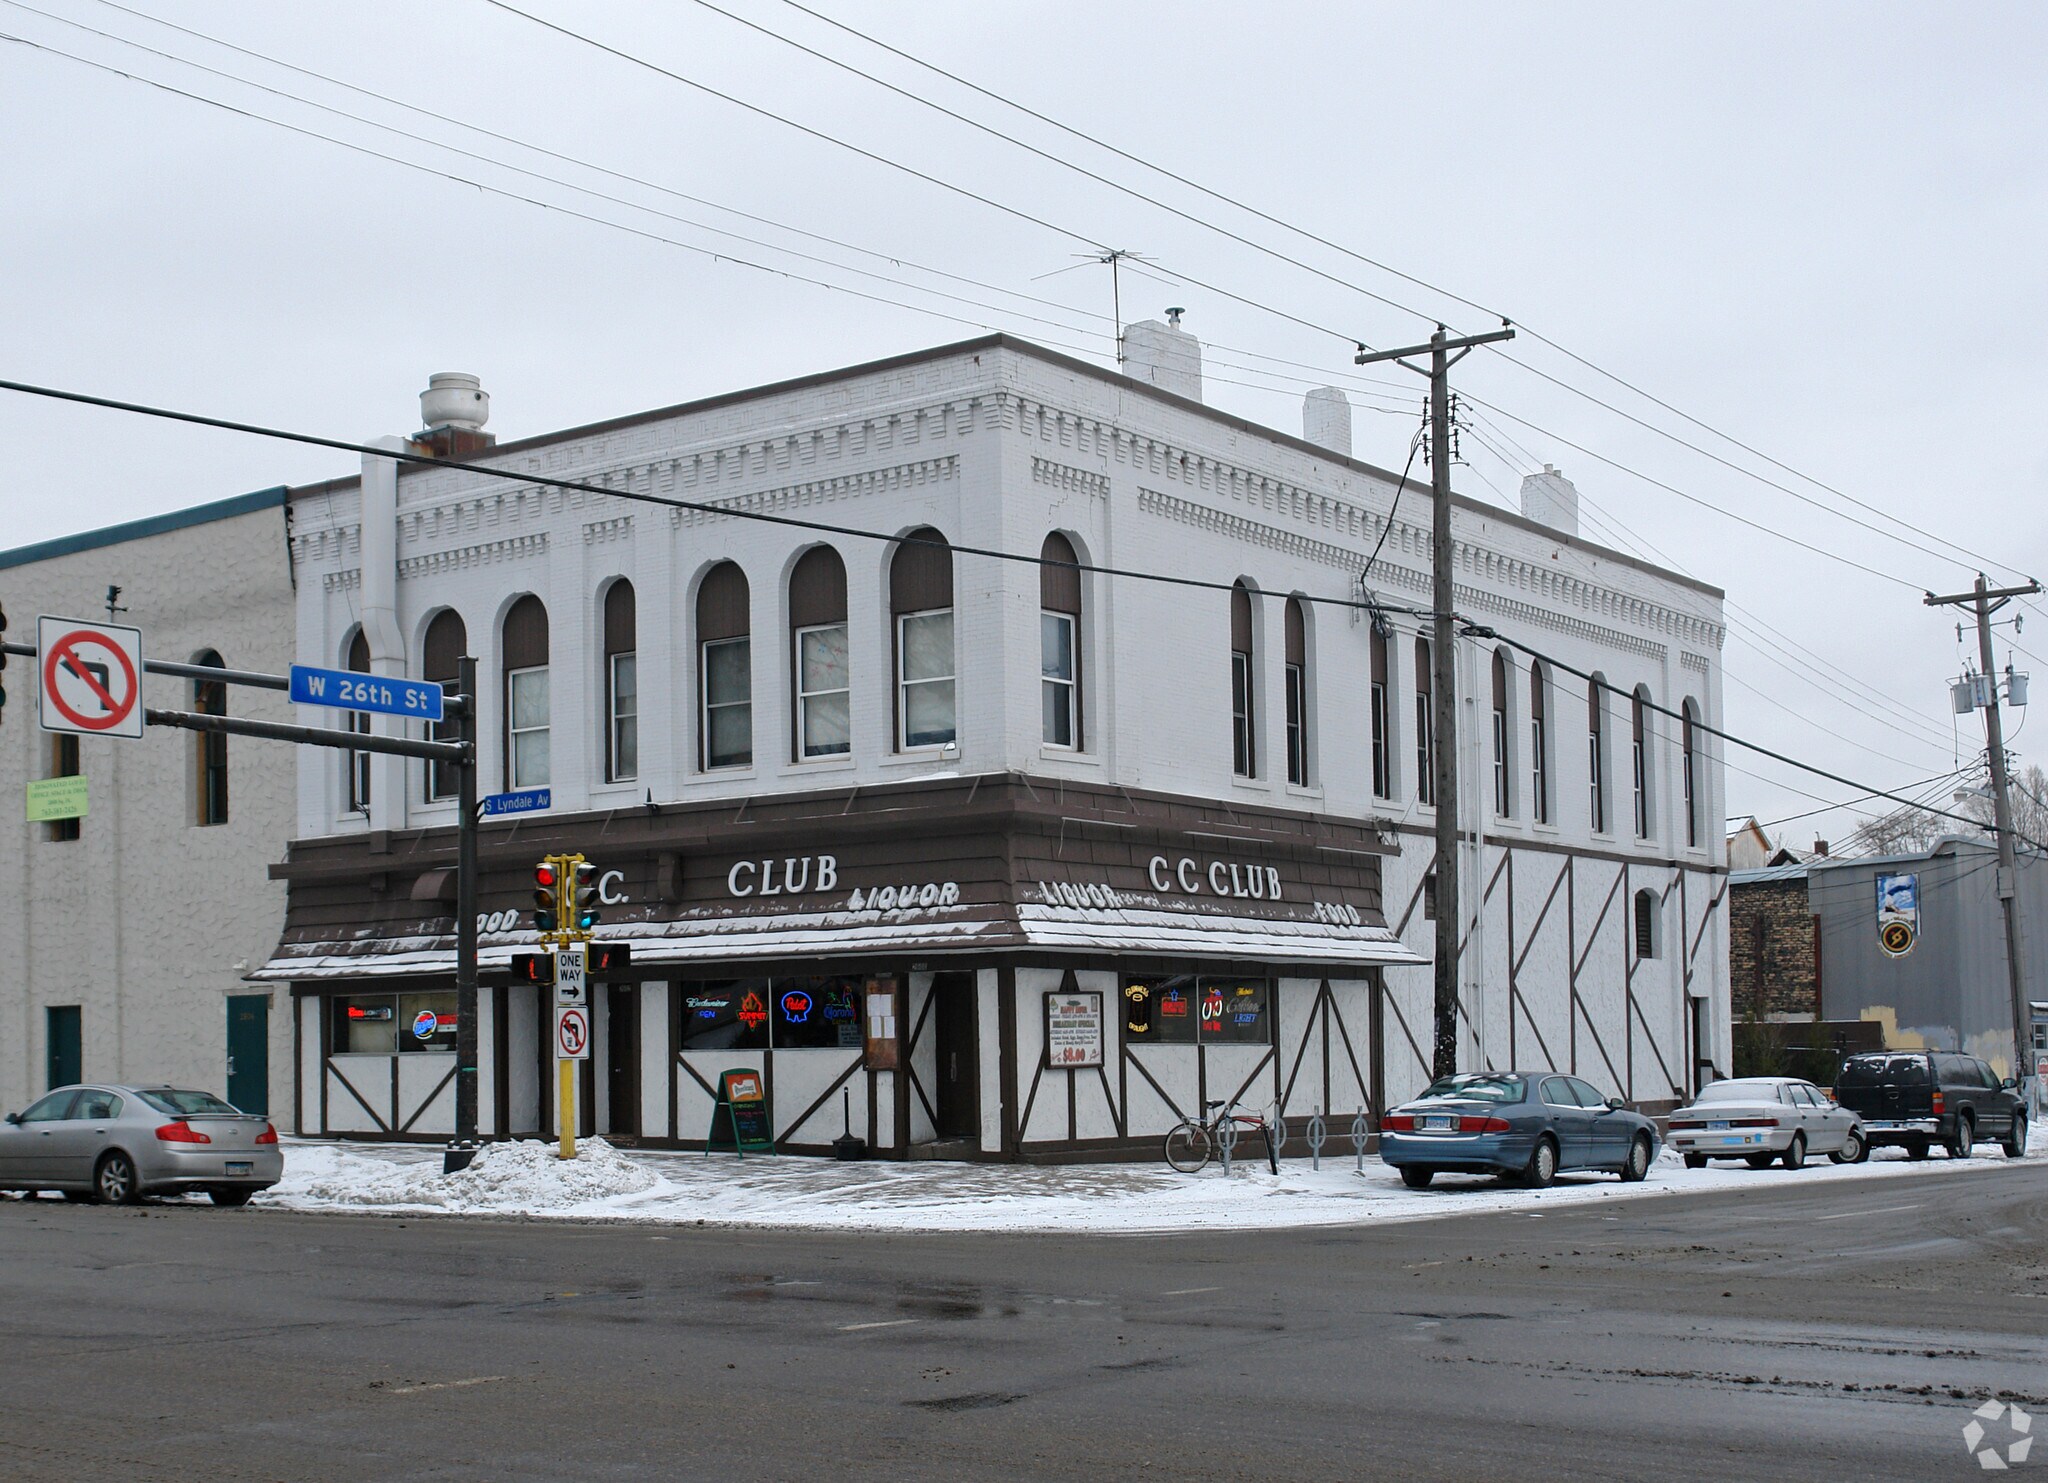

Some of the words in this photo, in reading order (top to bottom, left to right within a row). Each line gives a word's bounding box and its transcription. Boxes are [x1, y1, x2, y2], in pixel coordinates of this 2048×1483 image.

[308, 676, 325, 697] W
[340, 680, 392, 706] 26th
[405, 688, 427, 710] St
[486, 799, 492, 811] S
[497, 796, 532, 812] Lyndale
[537, 794, 548, 806] Av
[728, 855, 838, 897] CLUB
[1149, 856, 1169, 892] C
[1177, 857, 1199, 894] C
[1209, 861, 1282, 900] CLUB
[849, 882, 960, 911] LIQUOR
[1038, 880, 1121, 909] LIQUOR
[1313, 902, 1361, 925] FOOD
[560, 954, 581, 967] ONE
[560, 969, 581, 981] WAY
[686, 997, 730, 1008] Budweiser
[696, 1010, 716, 1019] PEN
[739, 1011, 766, 1021] SUMMIT
[823, 1006, 854, 1020] Corona
[1234, 1013, 1256, 1023] LIGHT
[1063, 1047, 1085, 1063] $8.00
